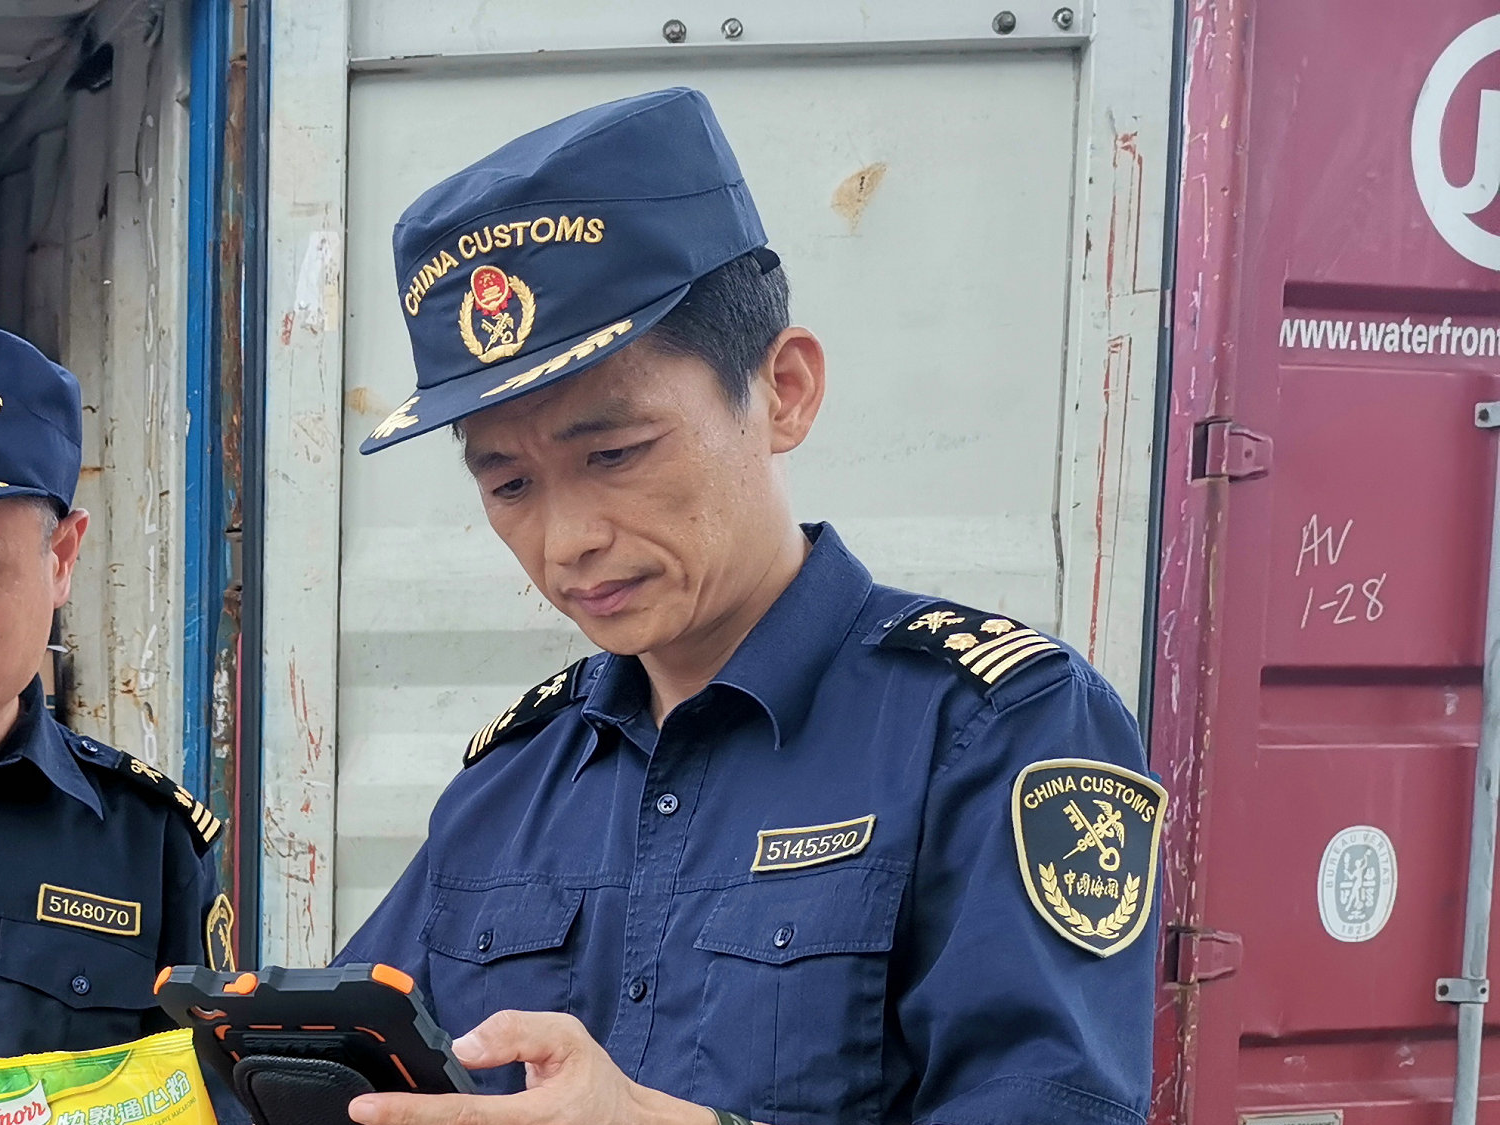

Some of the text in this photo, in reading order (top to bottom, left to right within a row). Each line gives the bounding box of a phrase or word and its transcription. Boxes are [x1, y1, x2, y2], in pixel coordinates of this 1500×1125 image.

[404, 215, 605, 316] CHINA CUSTOMS
[1301, 573, 1386, 629] 1-28
[1023, 775, 1155, 824] CHINA CUSTOMS
[767, 830, 857, 861] 5145590
[1326, 834, 1357, 889] BUREAU
[49, 896, 129, 926] 5168070
[172, 1097, 197, 1118] MACARONI
